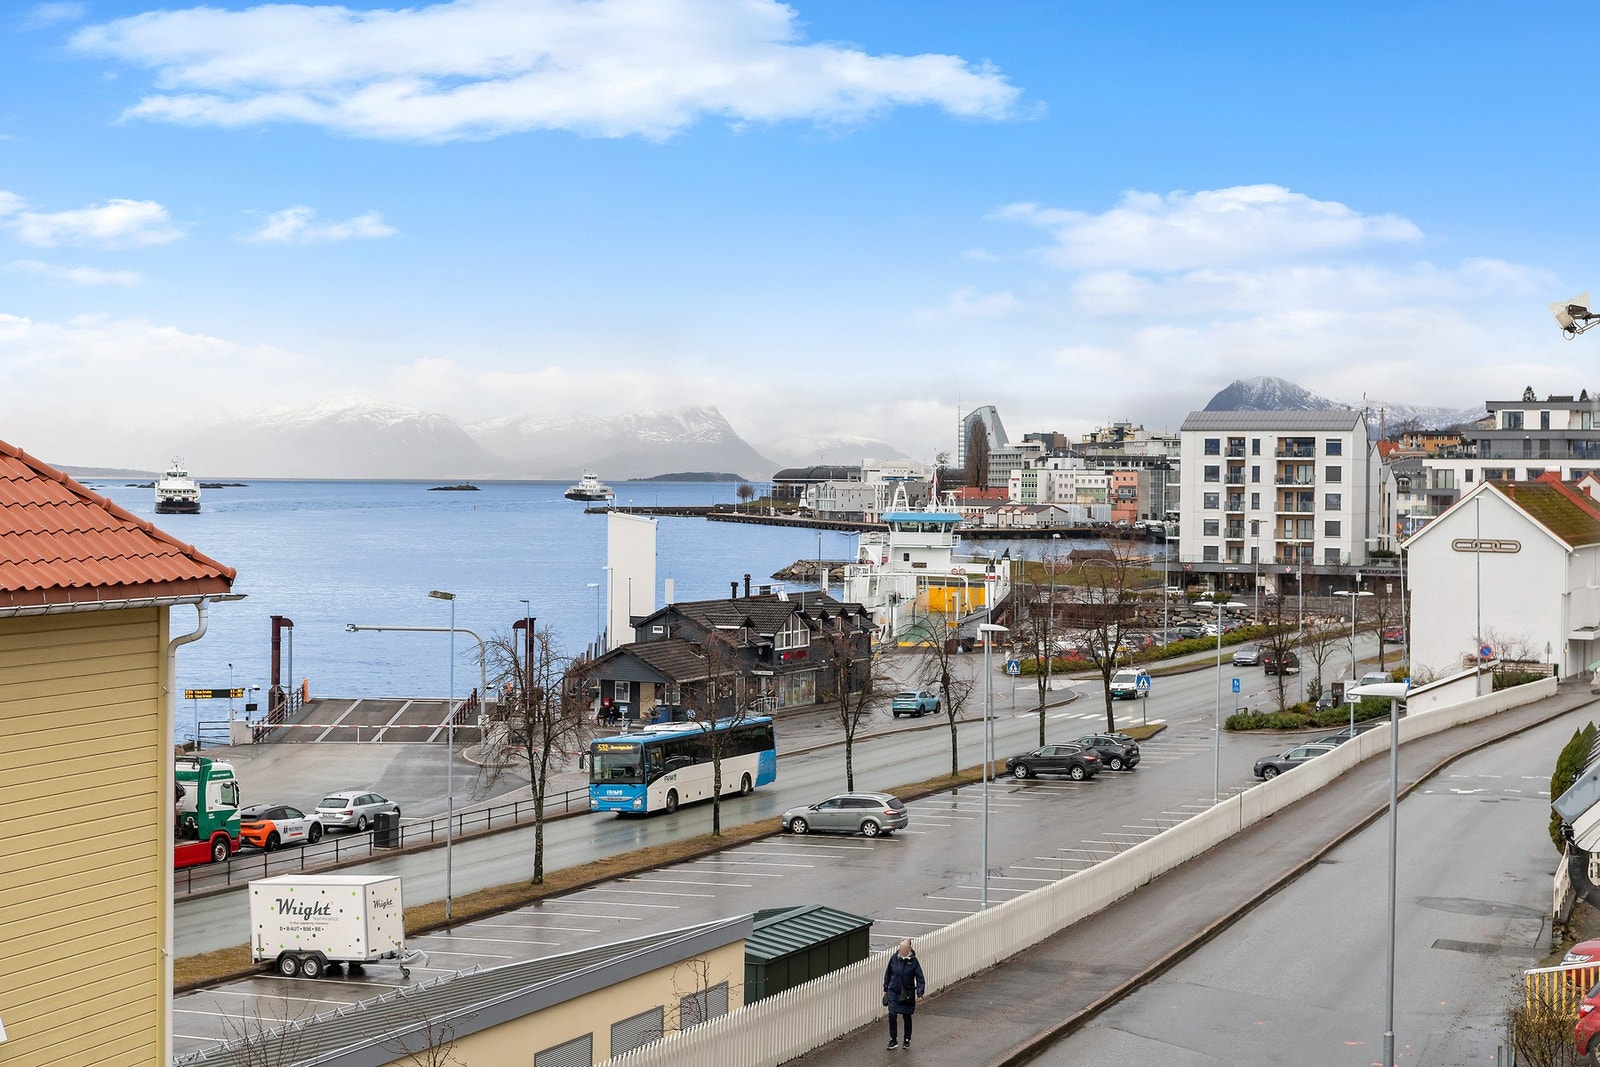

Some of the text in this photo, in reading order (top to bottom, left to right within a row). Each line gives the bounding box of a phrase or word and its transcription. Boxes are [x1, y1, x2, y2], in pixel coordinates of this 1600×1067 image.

[597, 743, 609, 752] 532
[373, 898, 393, 909] Wright
[275, 898, 332, 921] Wright
